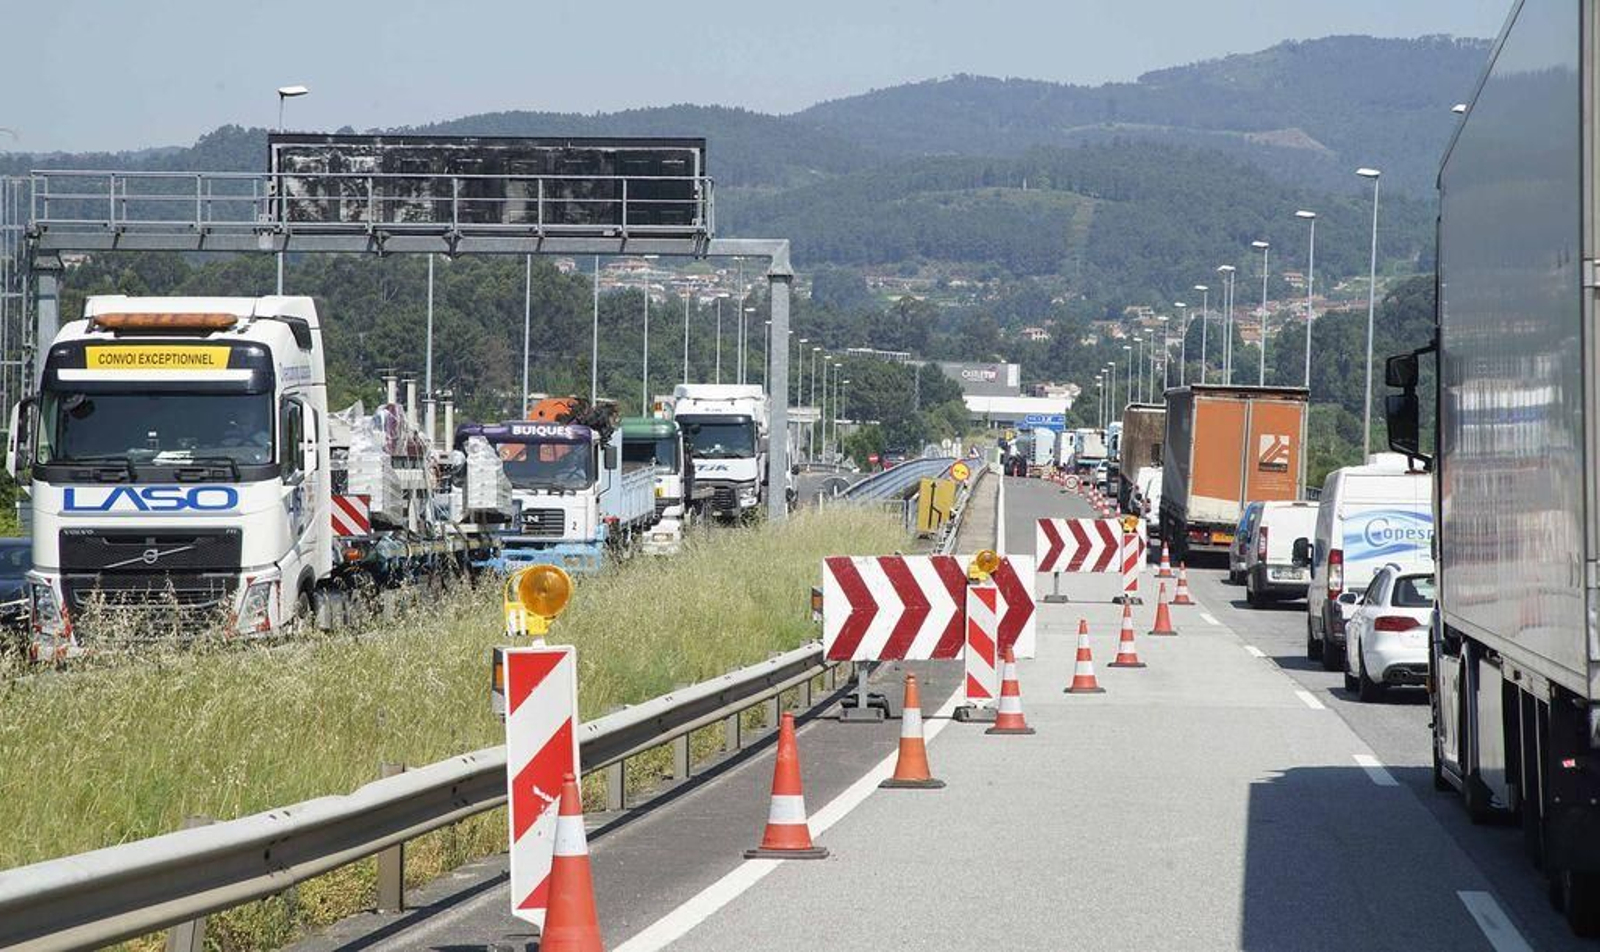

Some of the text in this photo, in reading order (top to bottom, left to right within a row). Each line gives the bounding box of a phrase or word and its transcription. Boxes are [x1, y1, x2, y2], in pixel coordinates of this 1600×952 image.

[98, 353, 215, 365] CONVOI EXCEPTIONNEL
[63, 486, 238, 511] LASO
